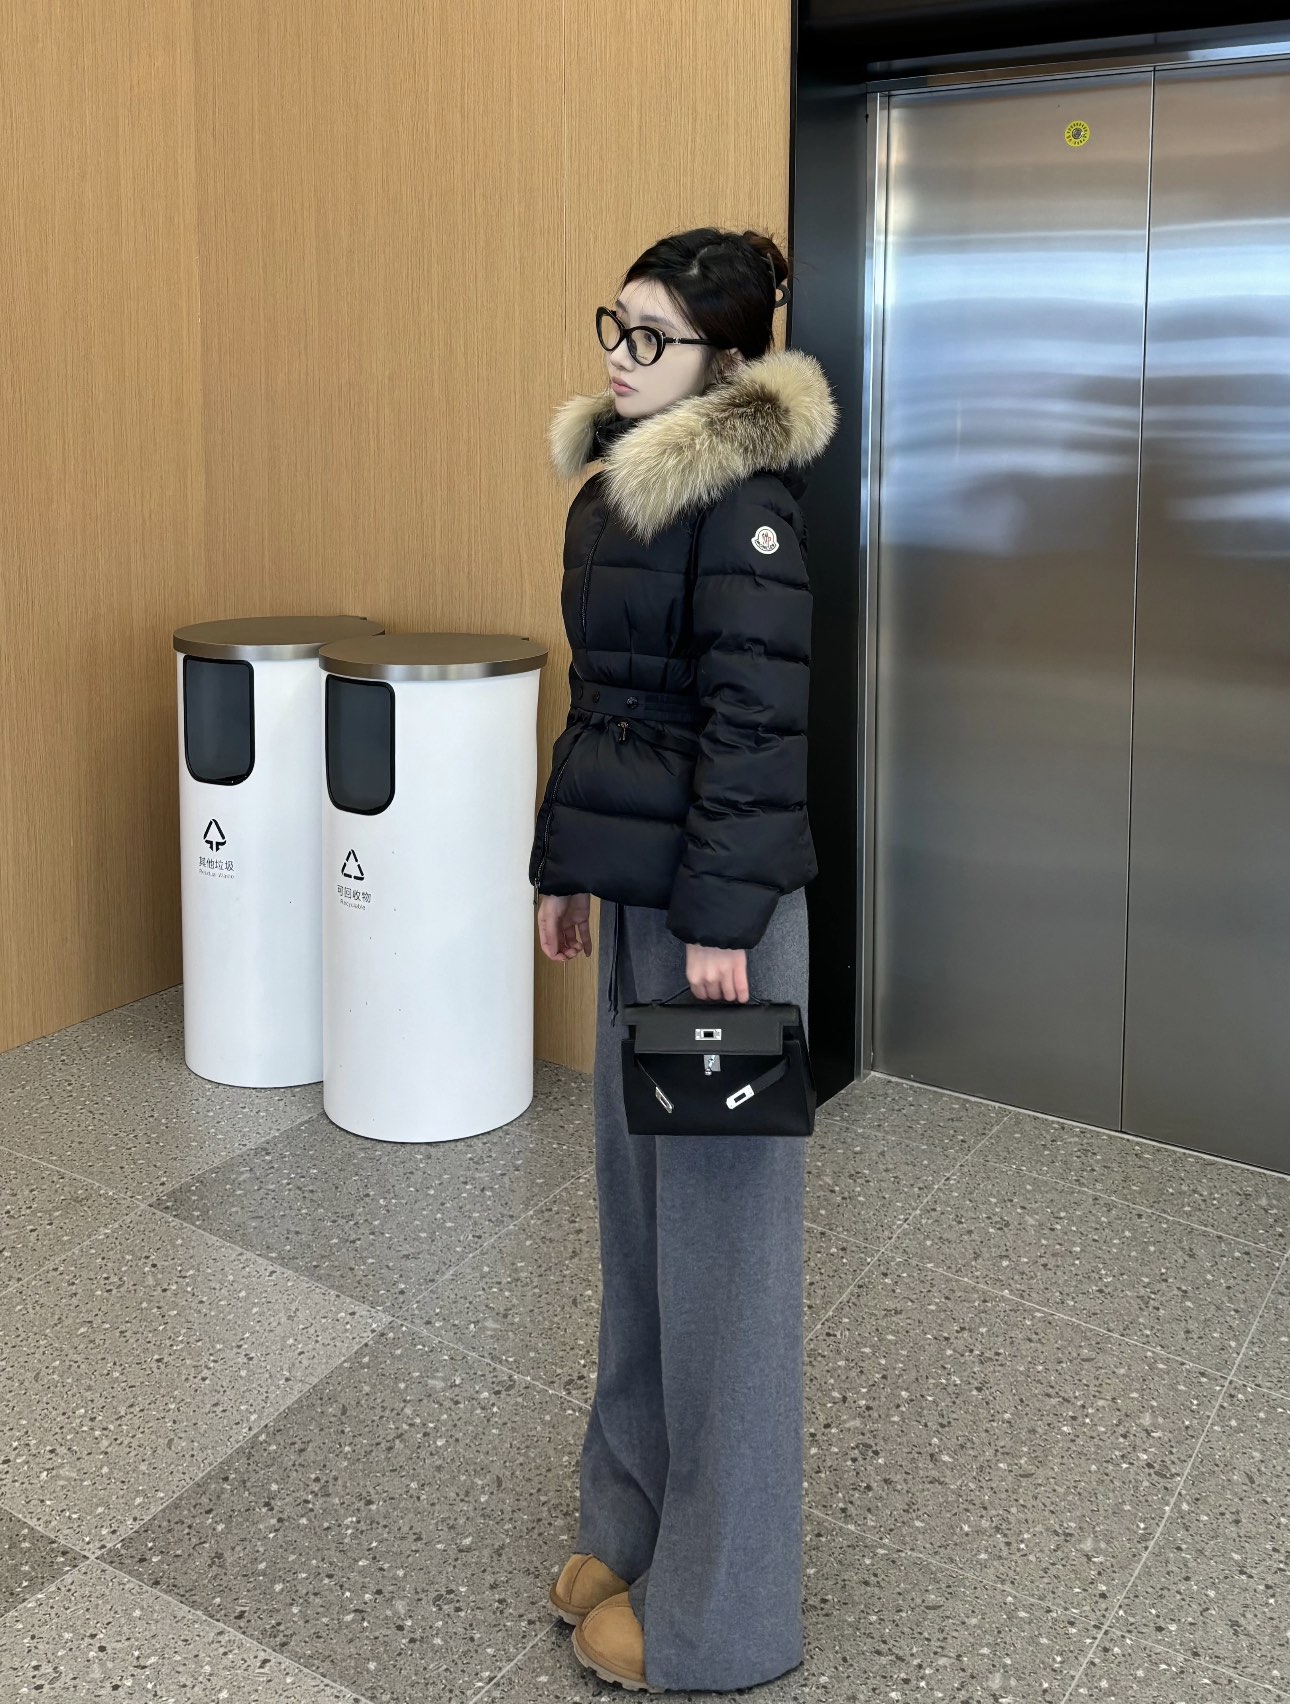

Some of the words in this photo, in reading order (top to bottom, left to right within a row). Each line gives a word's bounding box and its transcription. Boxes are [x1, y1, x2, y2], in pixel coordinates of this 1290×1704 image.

[199, 856, 234, 871] 其他垃圾
[337, 884, 372, 903] 可回收物
